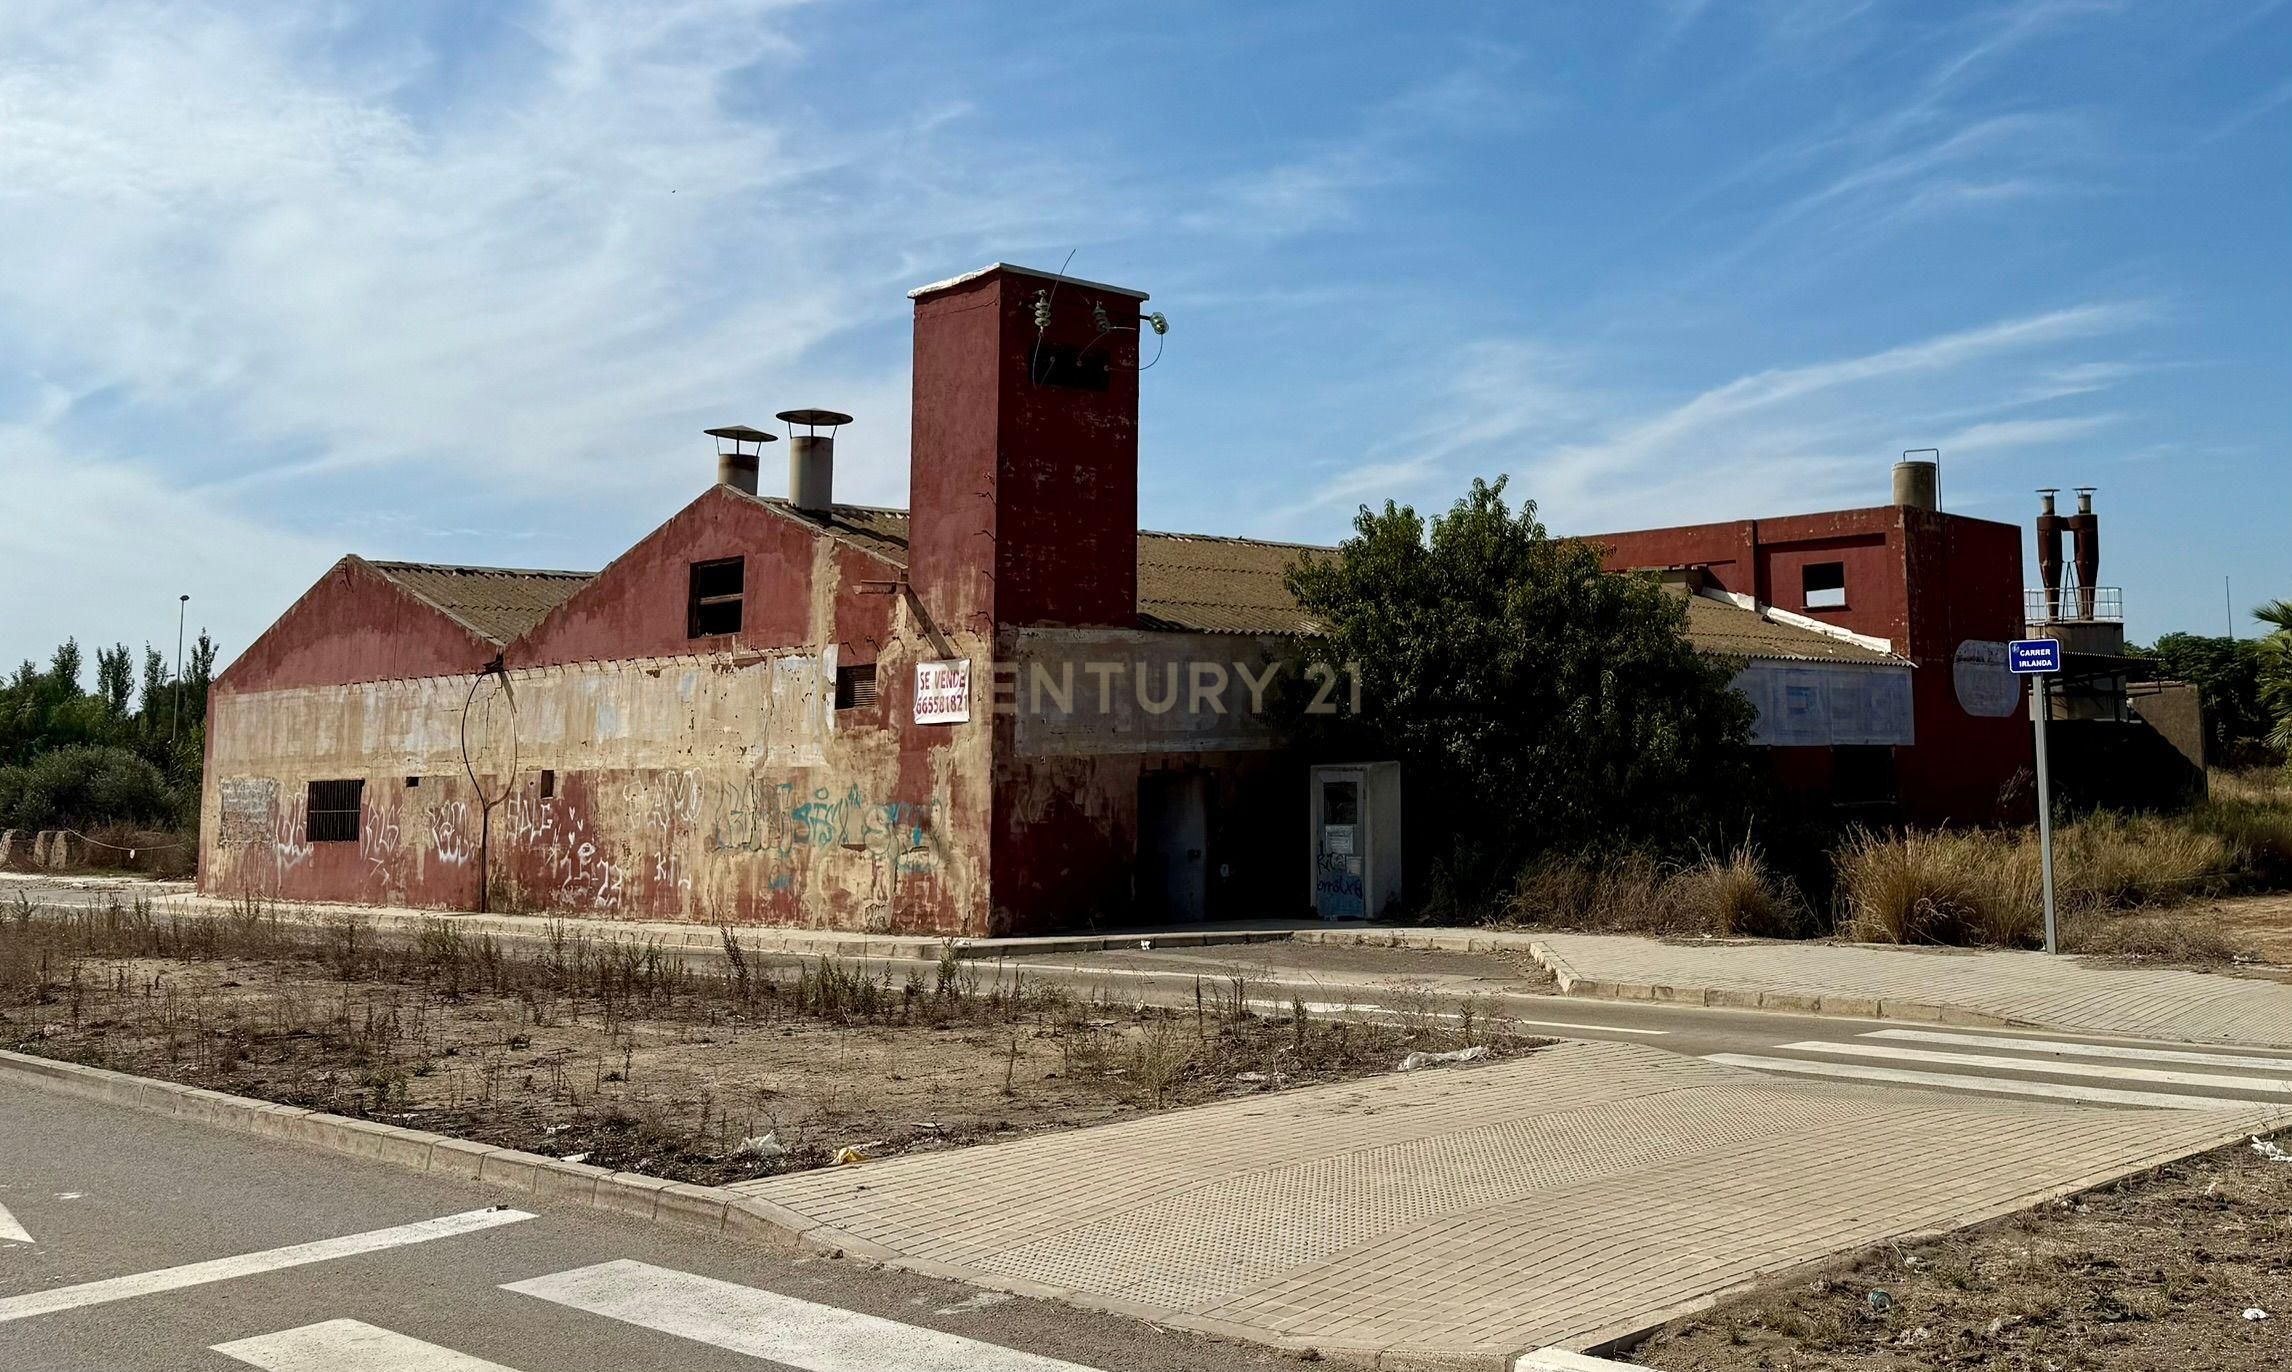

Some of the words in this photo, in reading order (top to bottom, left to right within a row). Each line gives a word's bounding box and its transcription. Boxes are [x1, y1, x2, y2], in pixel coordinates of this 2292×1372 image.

[920, 671, 930, 690] SE
[934, 670, 966, 689] VENDE
[916, 694, 968, 714] 665581821
